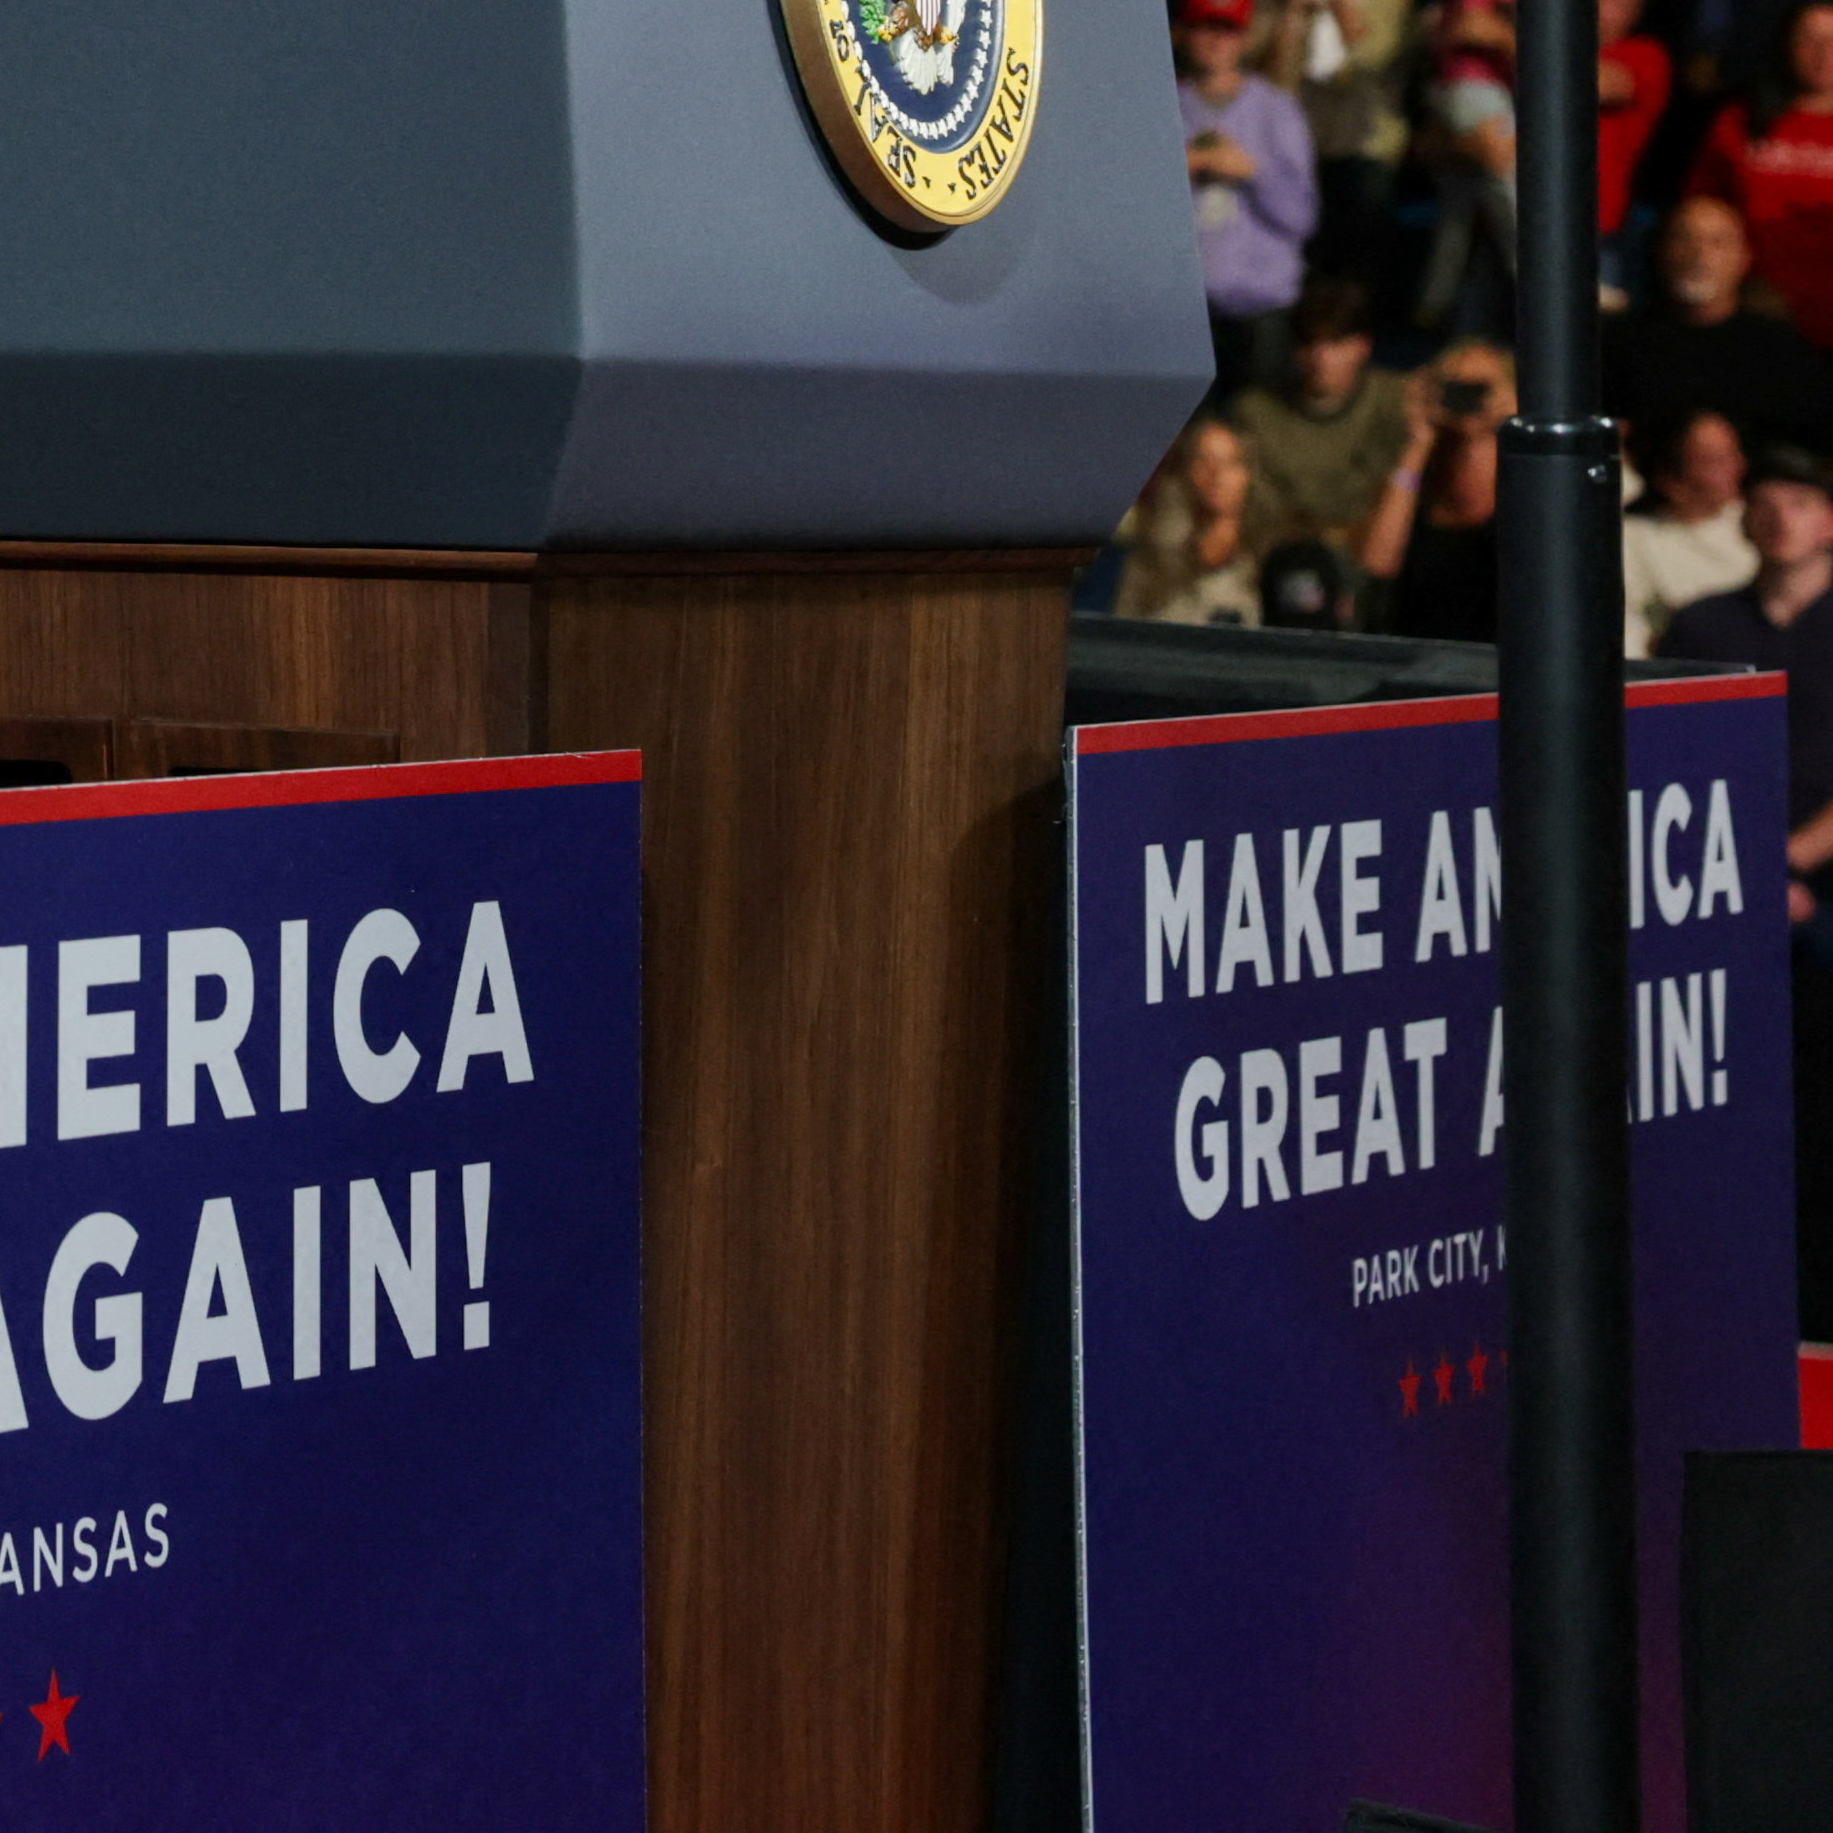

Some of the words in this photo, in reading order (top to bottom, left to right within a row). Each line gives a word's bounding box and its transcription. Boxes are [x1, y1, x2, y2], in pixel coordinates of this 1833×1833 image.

[829, 19, 851, 62] OF
[854, 65, 917, 189] SEAL
[957, 45, 1030, 202] STATES
[1145, 819, 1383, 1005] MAKE
[1415, 779, 1743, 963] AMICA
[1174, 1018, 1447, 1222] GREAT
[1479, 969, 1728, 1157] AIN!
[1352, 1246, 1420, 1308] PARK
[1428, 1229, 1490, 1288] CITY,
